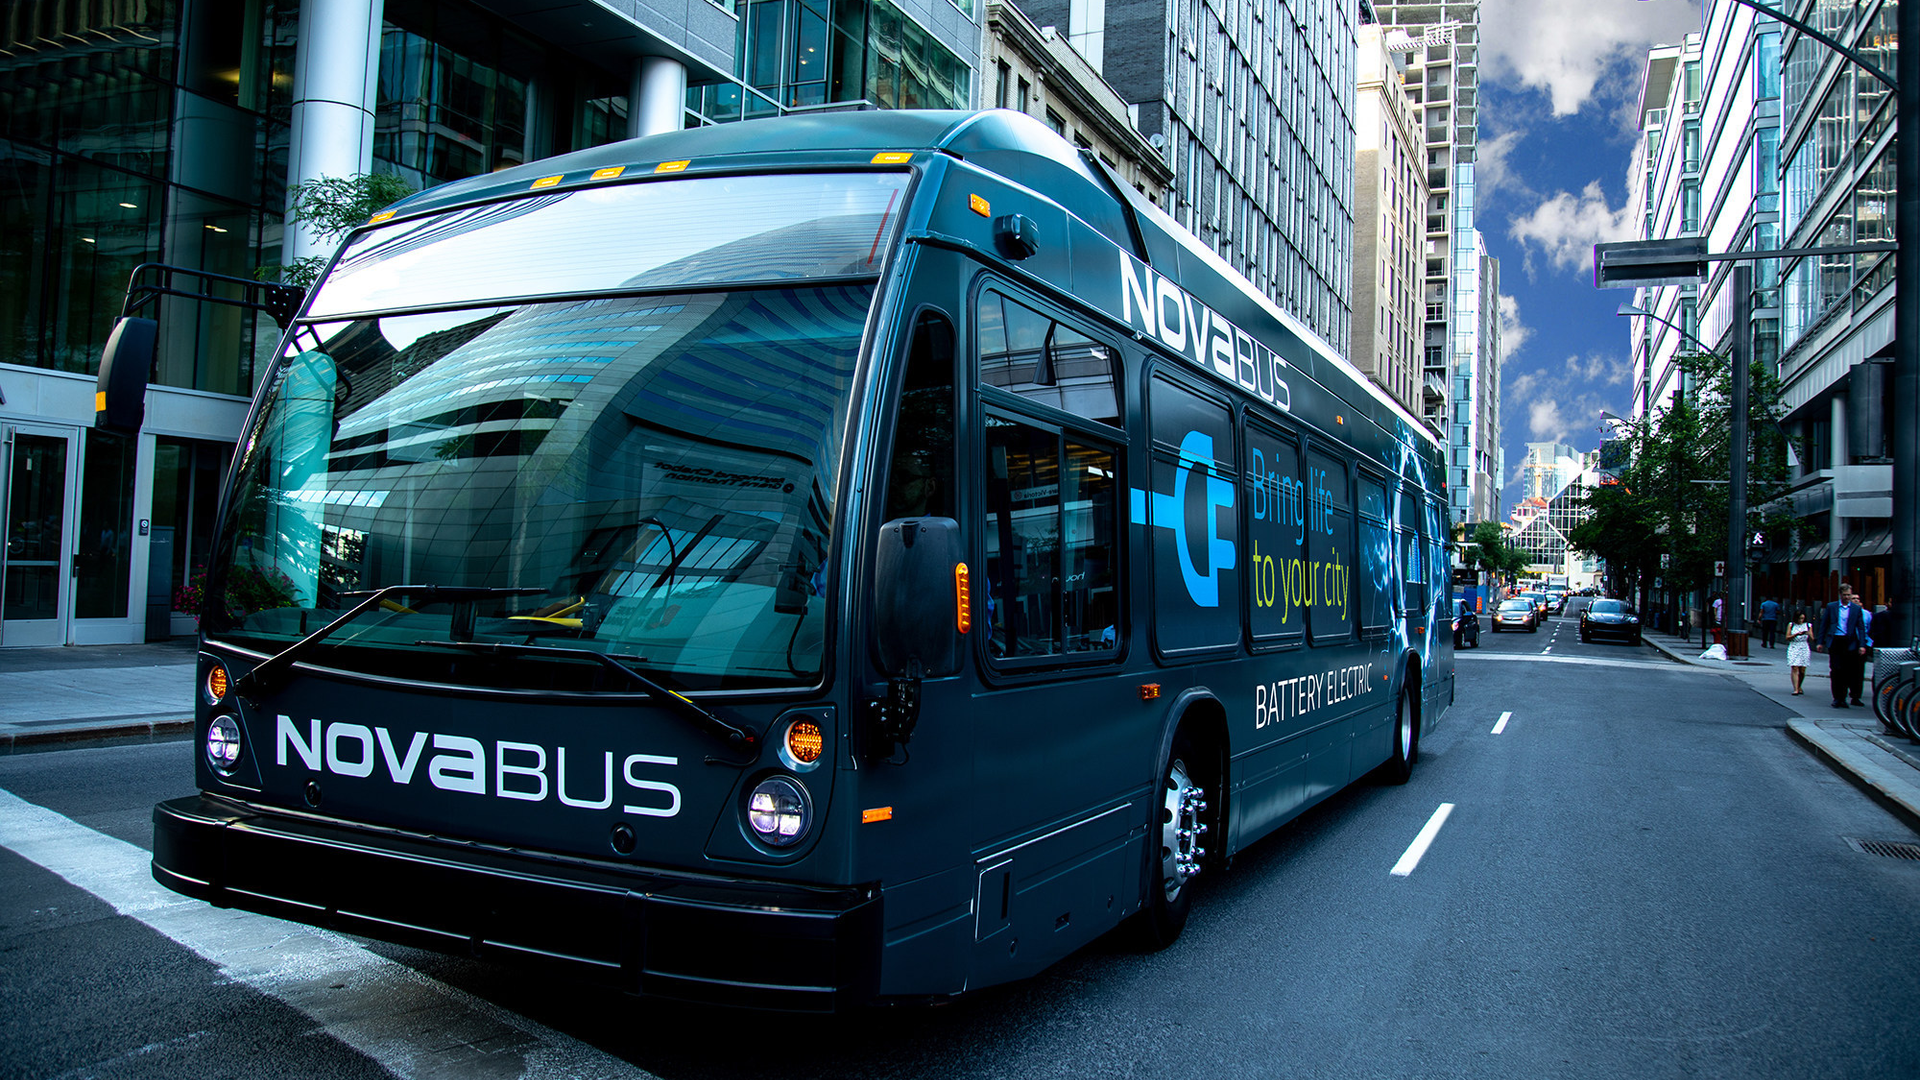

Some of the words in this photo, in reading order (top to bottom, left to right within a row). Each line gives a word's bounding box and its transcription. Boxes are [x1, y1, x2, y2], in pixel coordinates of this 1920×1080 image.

[1252, 447, 1305, 546] Bring
[1308, 466, 1334, 536] life
[1252, 539, 1275, 608] to
[1279, 557, 1320, 625] your
[1323, 546, 1350, 621] city
[1256, 672, 1325, 730] BATTERY
[1327, 662, 1373, 706] ELECTRIC
